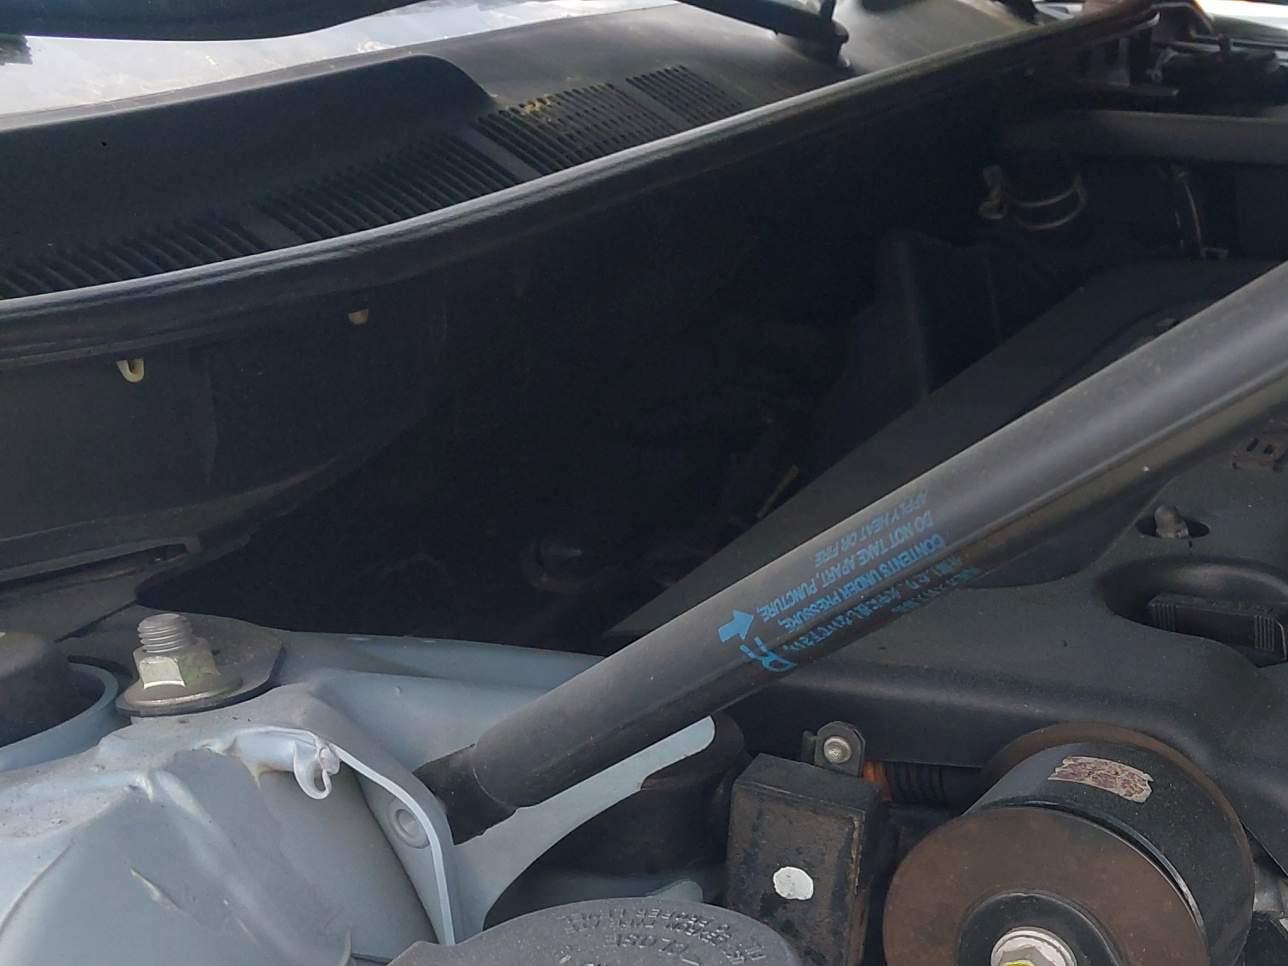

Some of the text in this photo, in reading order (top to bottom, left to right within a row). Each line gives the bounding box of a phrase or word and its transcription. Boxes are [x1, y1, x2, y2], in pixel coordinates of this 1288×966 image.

[871, 521, 915, 559] NOT
[913, 510, 934, 534] DO
[855, 538, 889, 567] TAKE
[878, 531, 945, 578] CONTENTS
[816, 555, 856, 588] APART,
[838, 567, 882, 601] UNDER
[756, 578, 818, 622] PUNCTURE,
[777, 590, 842, 634] PRESSURE,
